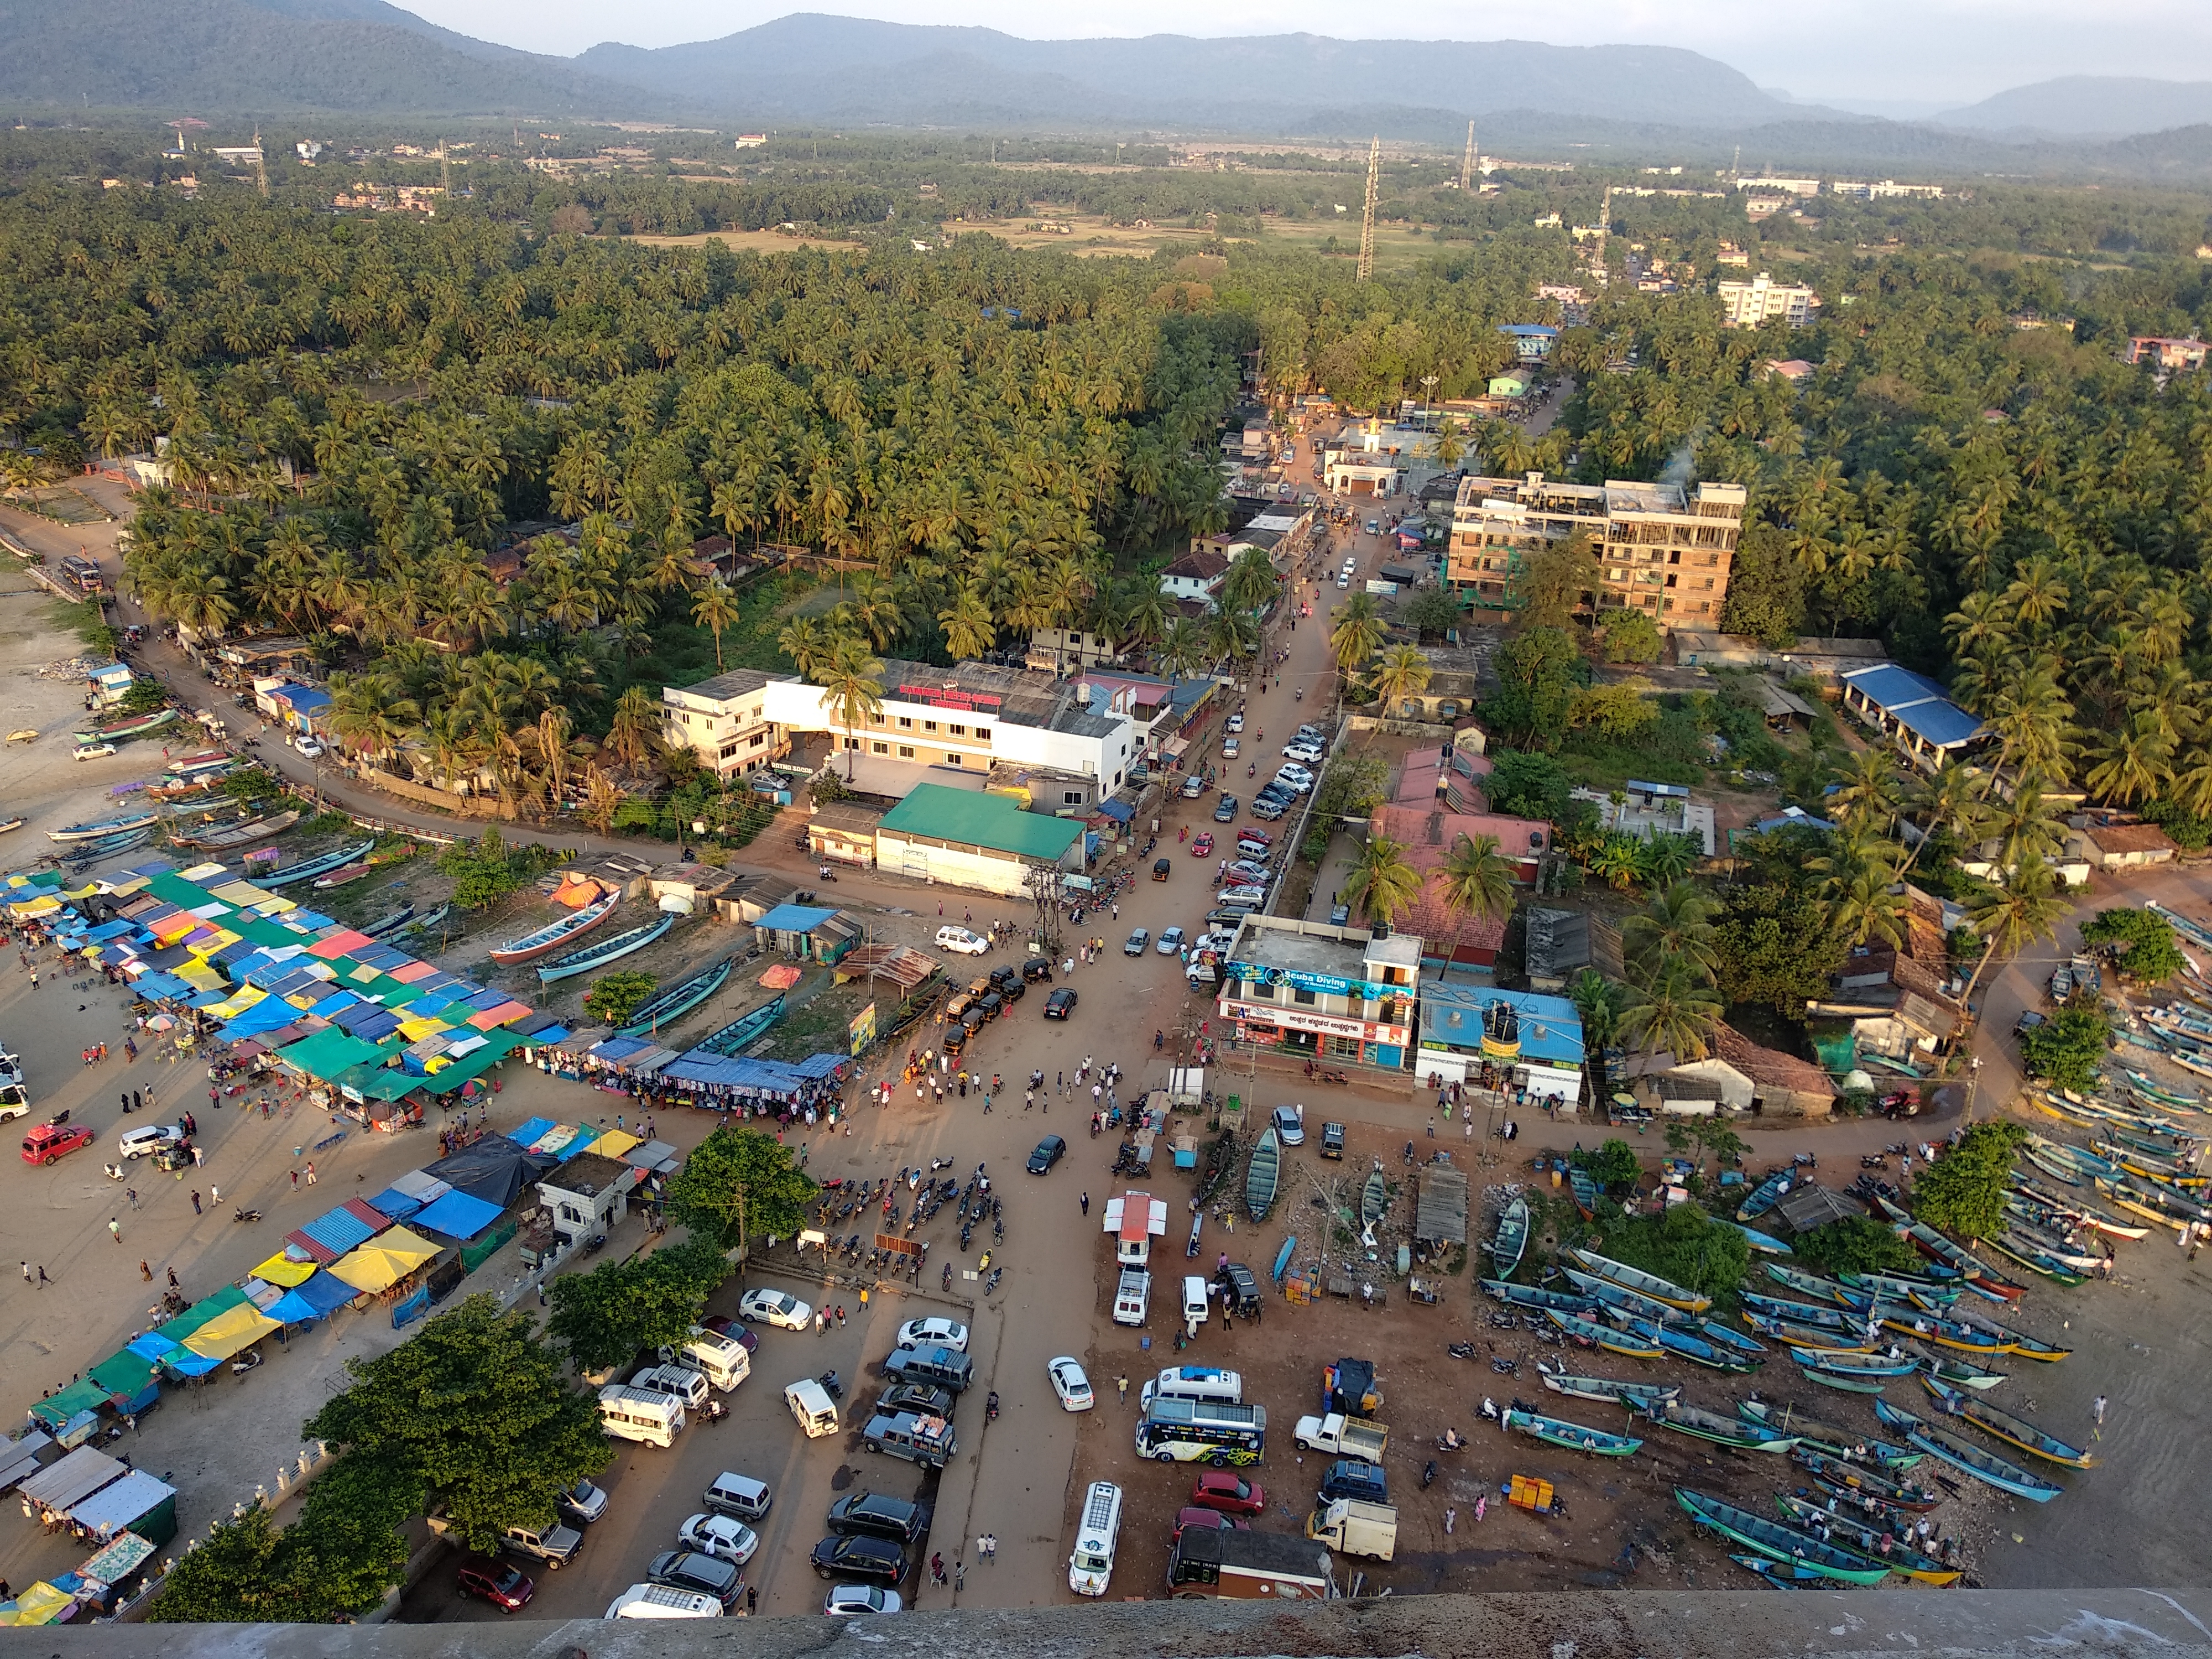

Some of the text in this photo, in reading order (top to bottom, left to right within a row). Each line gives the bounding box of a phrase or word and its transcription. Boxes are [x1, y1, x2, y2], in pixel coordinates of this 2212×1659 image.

[772, 762, 791, 770] RATNA
[1285, 971, 1346, 988] Scuba Diving
[1308, 1018, 1329, 1027] ಕನ್ನಡದ
